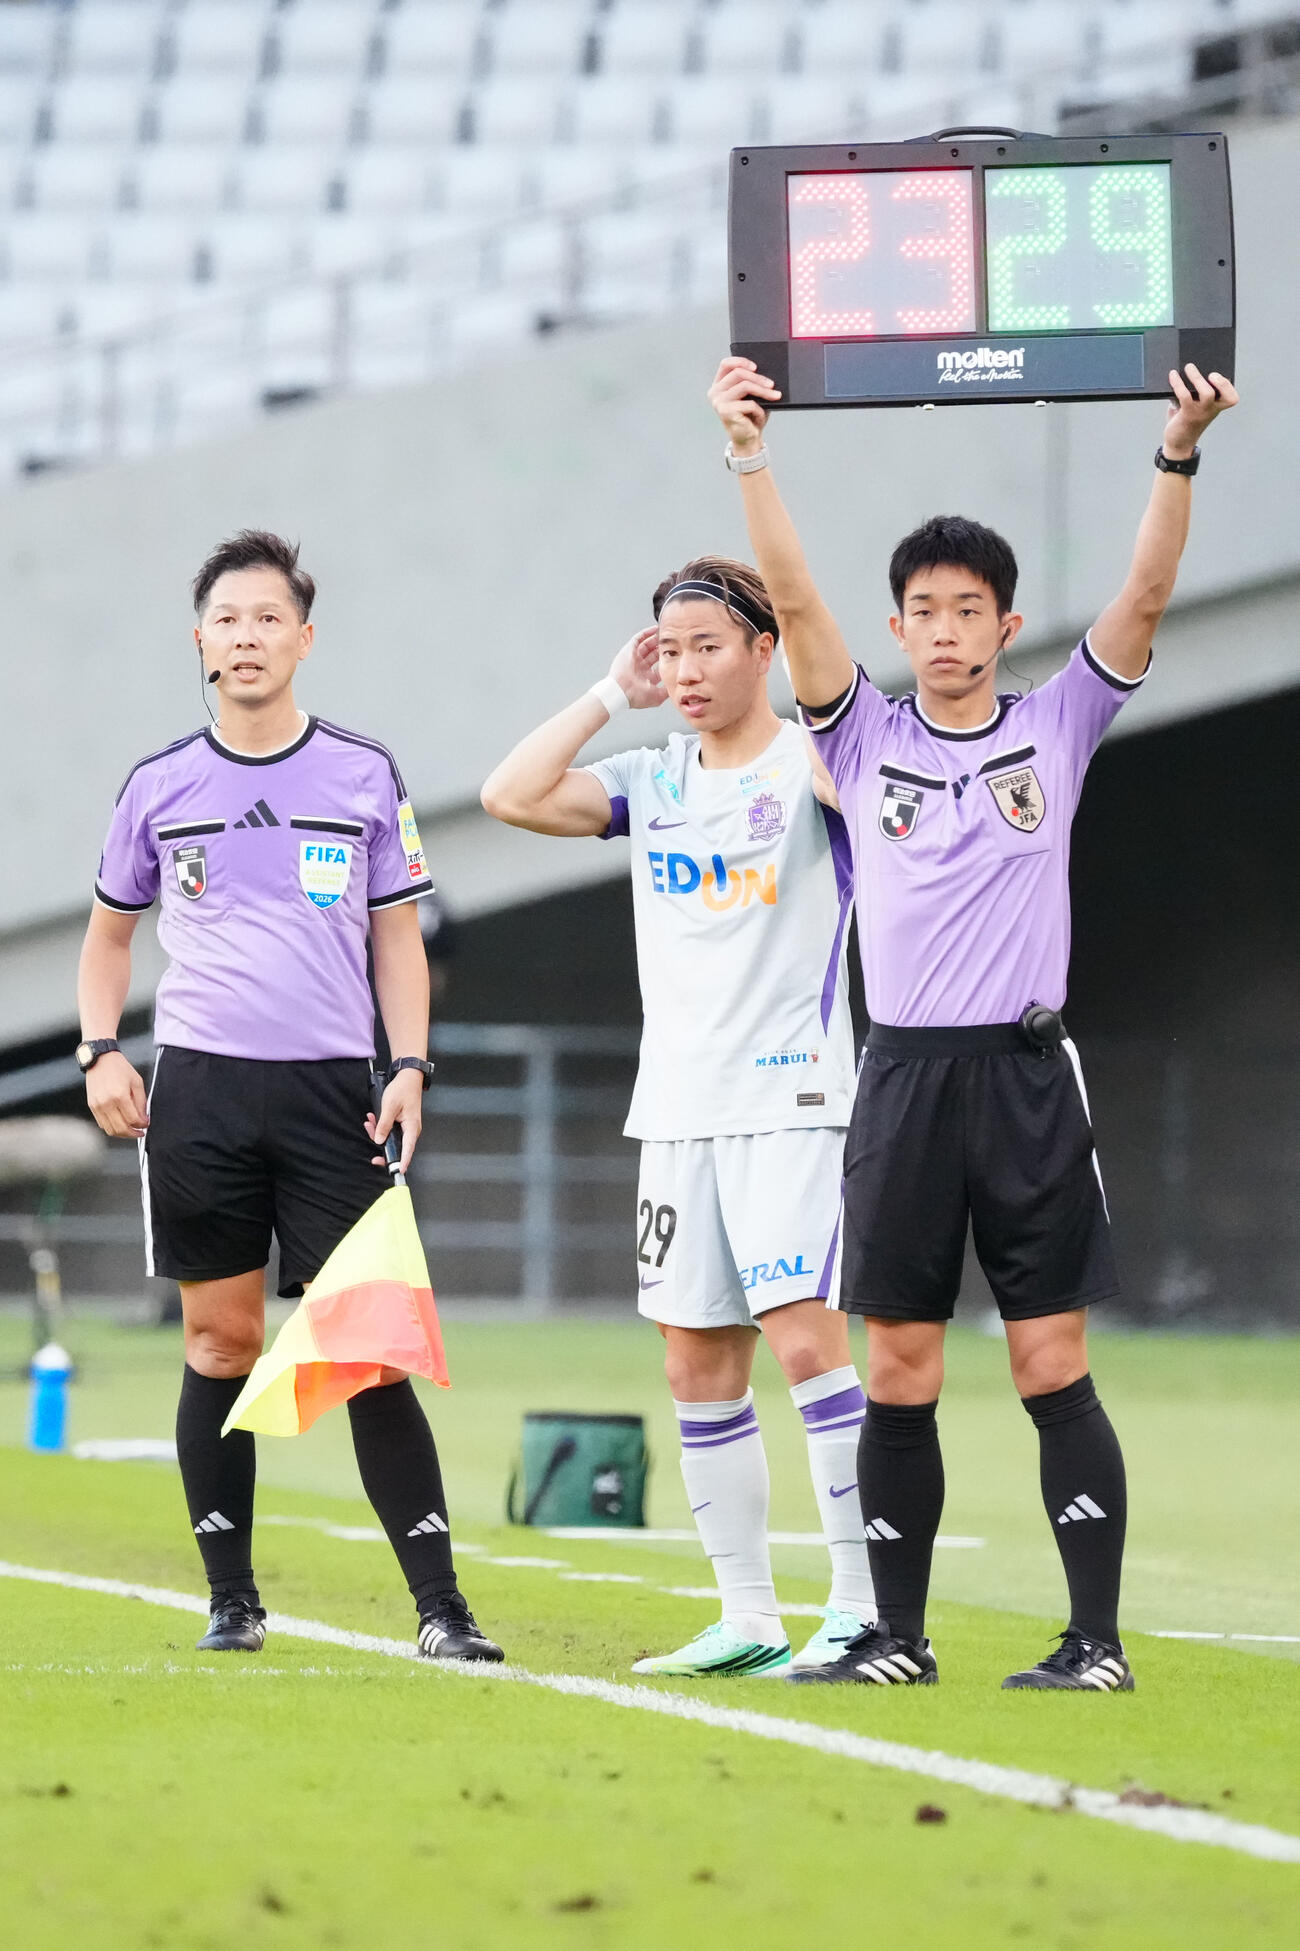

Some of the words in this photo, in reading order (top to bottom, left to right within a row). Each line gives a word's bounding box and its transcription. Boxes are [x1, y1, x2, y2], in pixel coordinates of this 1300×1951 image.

[793, 178, 974, 332] 23
[991, 172, 1168, 328] 29
[937, 347, 1025, 369] molten
[993, 772, 1033, 791] REFEREE
[1019, 812, 1038, 825] JFA
[305, 846, 346, 864] FIFA
[648, 851, 777, 912] EDION
[314, 894, 333, 903] 2026
[755, 1053, 807, 1067] MARUI
[638, 1199, 677, 1268] 29
